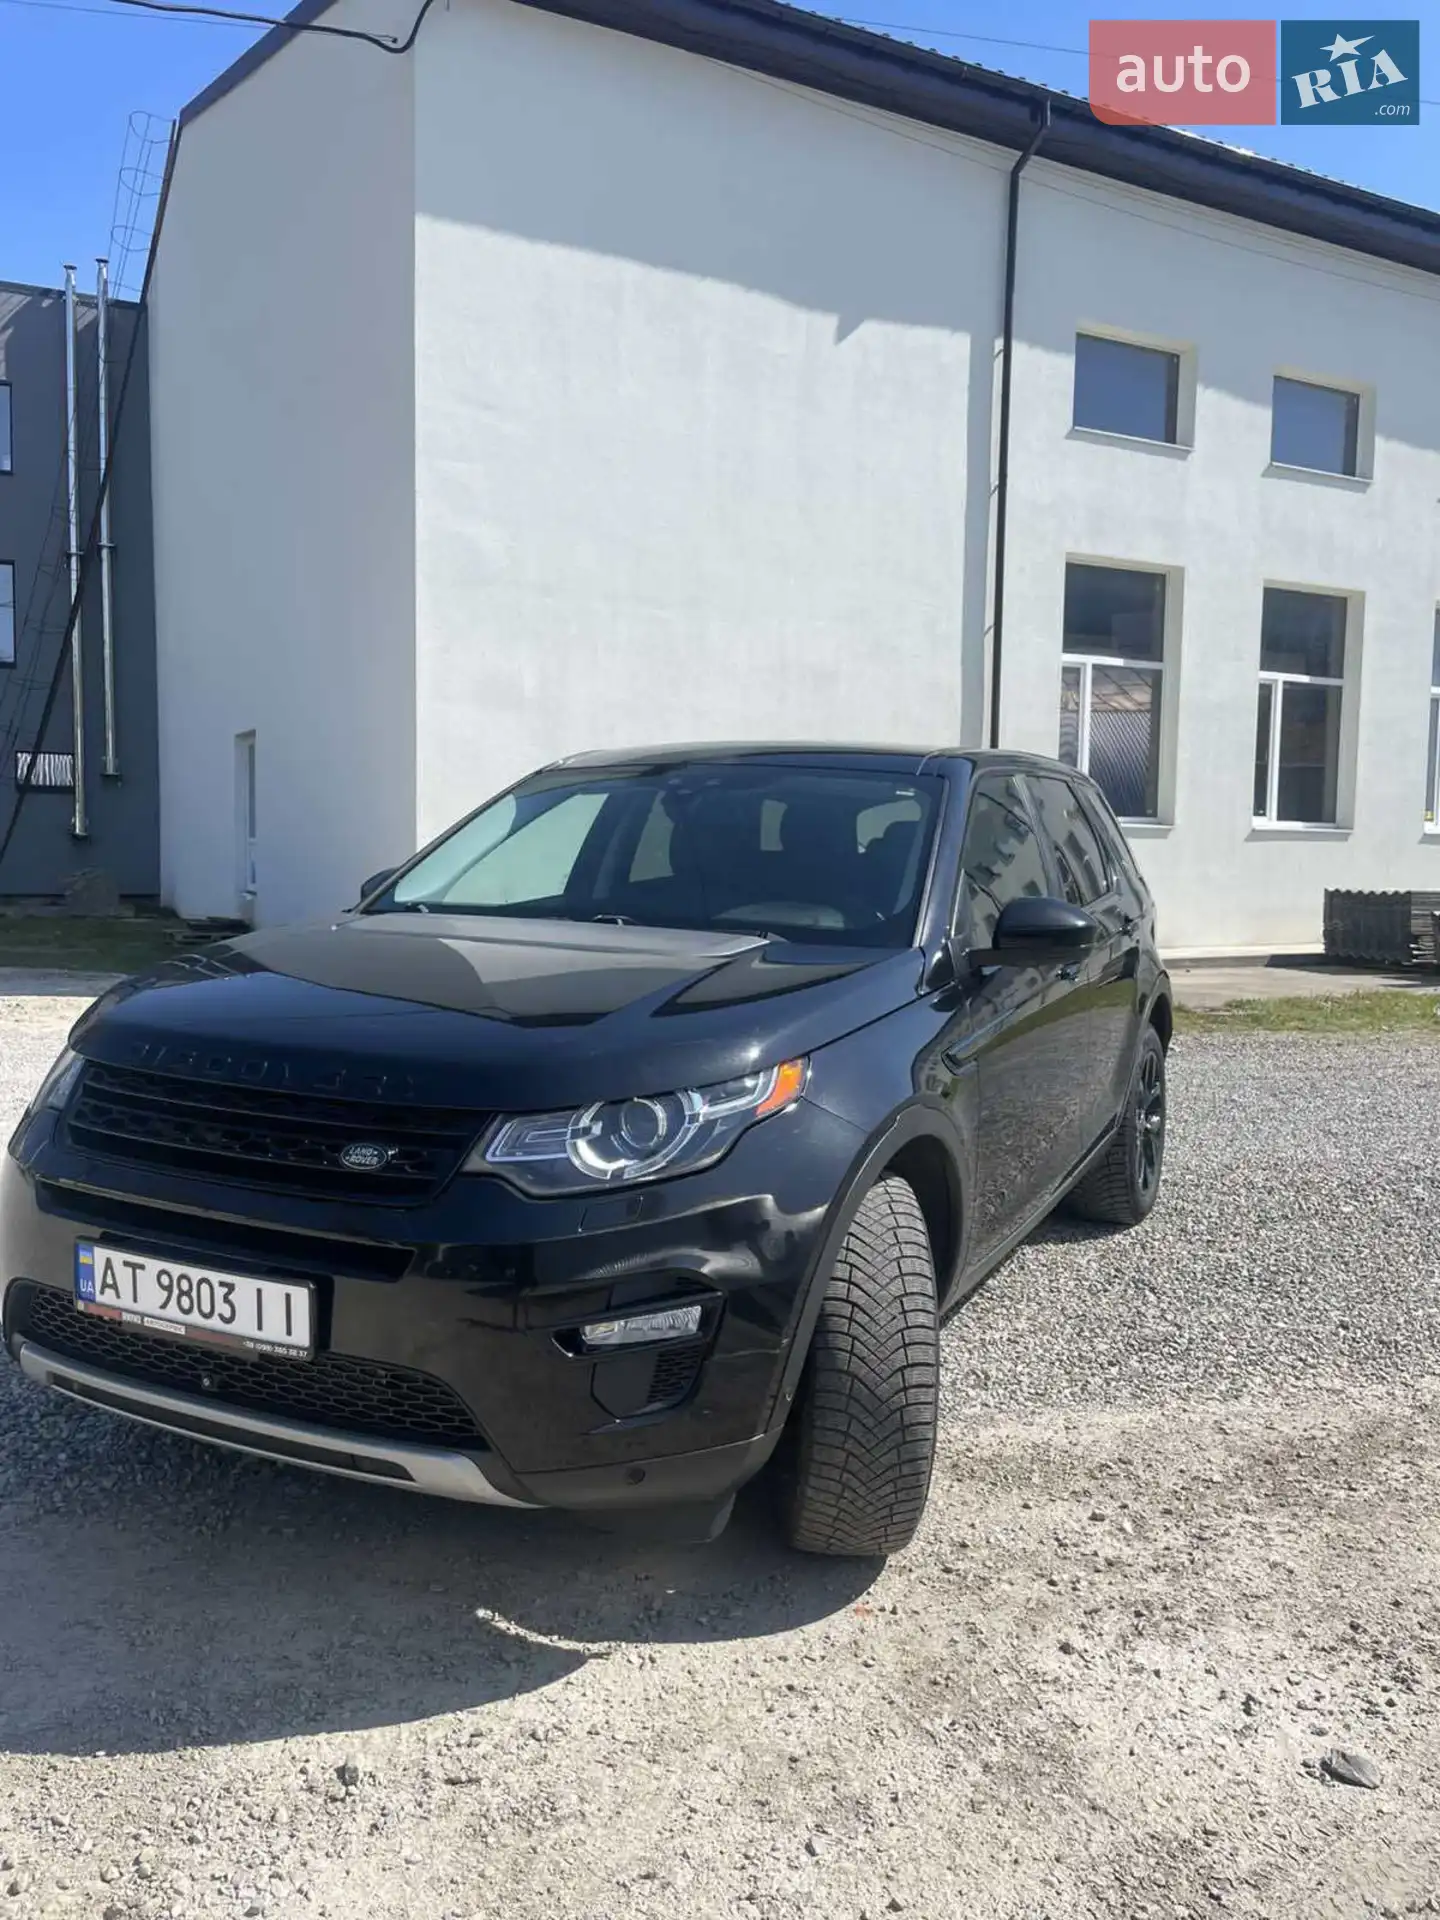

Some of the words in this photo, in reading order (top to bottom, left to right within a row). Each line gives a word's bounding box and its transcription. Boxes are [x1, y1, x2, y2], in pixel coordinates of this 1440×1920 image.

[80, 1278, 94, 1293] UA
[99, 1257, 146, 1304] AT
[156, 1268, 236, 1325] 9803
